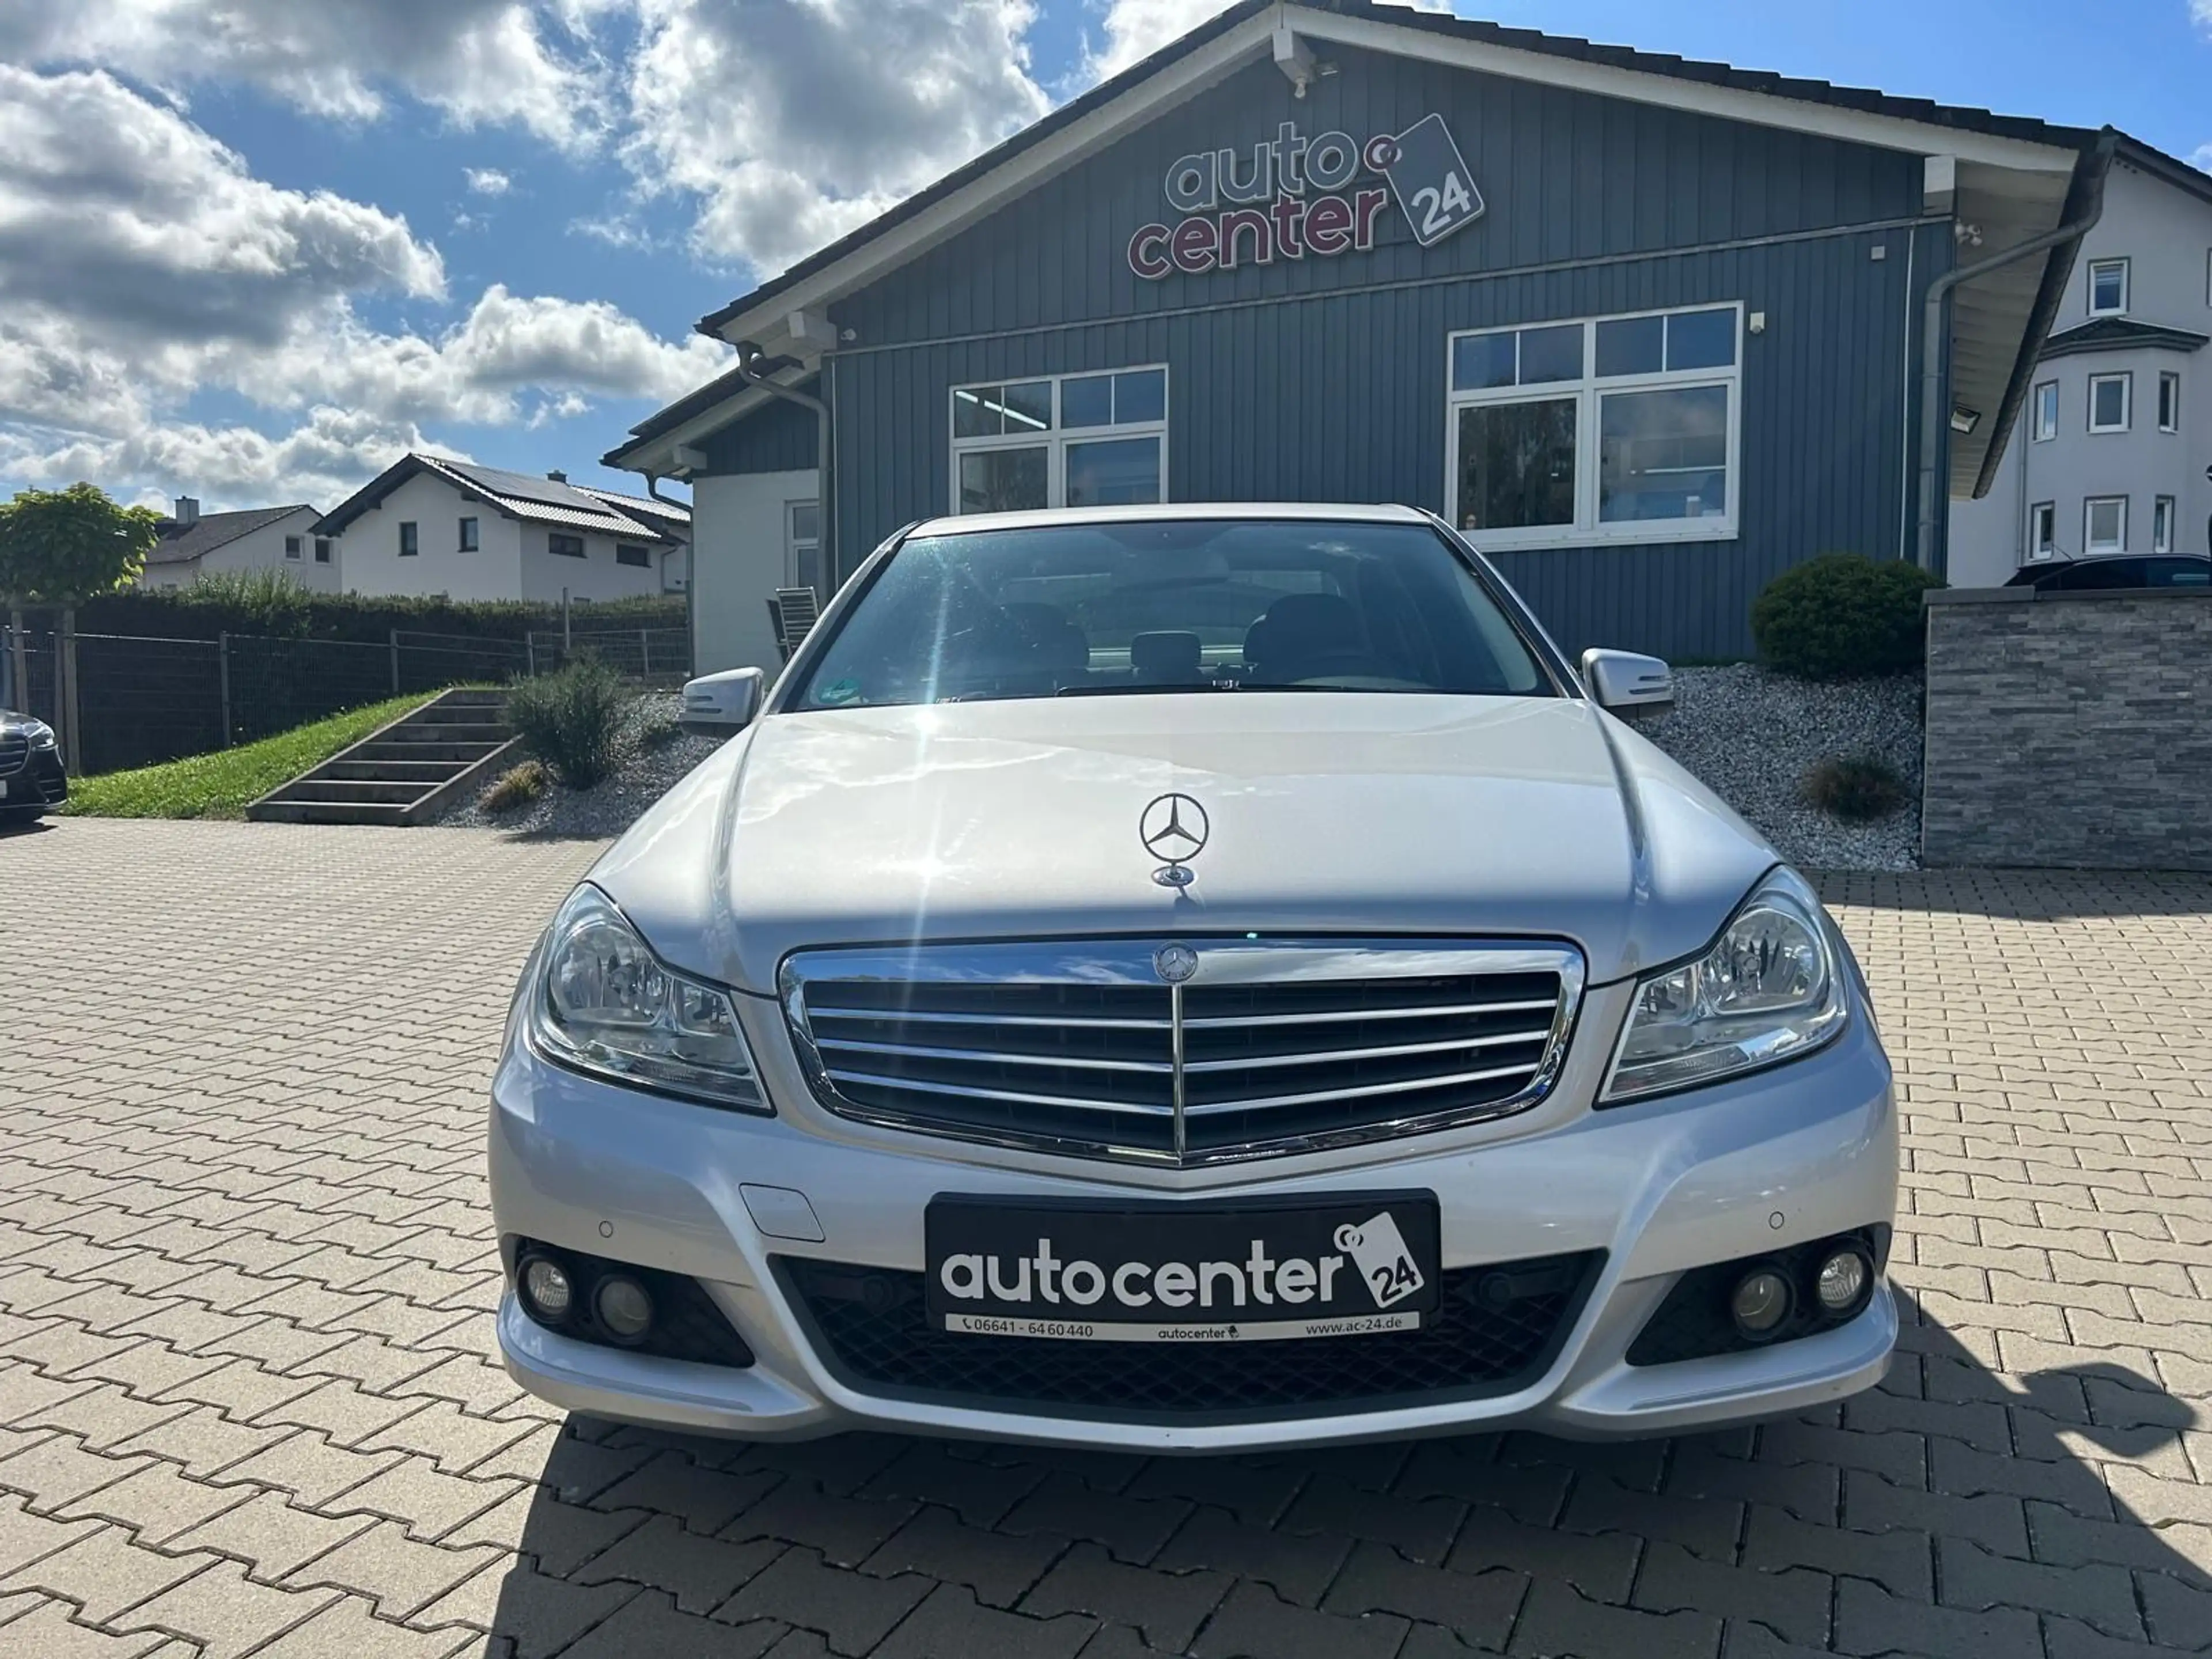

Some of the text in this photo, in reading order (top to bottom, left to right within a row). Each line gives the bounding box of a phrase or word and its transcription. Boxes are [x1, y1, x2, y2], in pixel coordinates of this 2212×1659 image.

[1165, 122, 1359, 213] auto
[1411, 171, 1471, 237] 24
[1127, 187, 1388, 279] center
[1372, 1255, 1417, 1302] 24
[974, 1319, 1015, 1332] 06641
[1158, 1327, 1226, 1339] autocenter
[1305, 1316, 1403, 1335] www.ac-24.de
